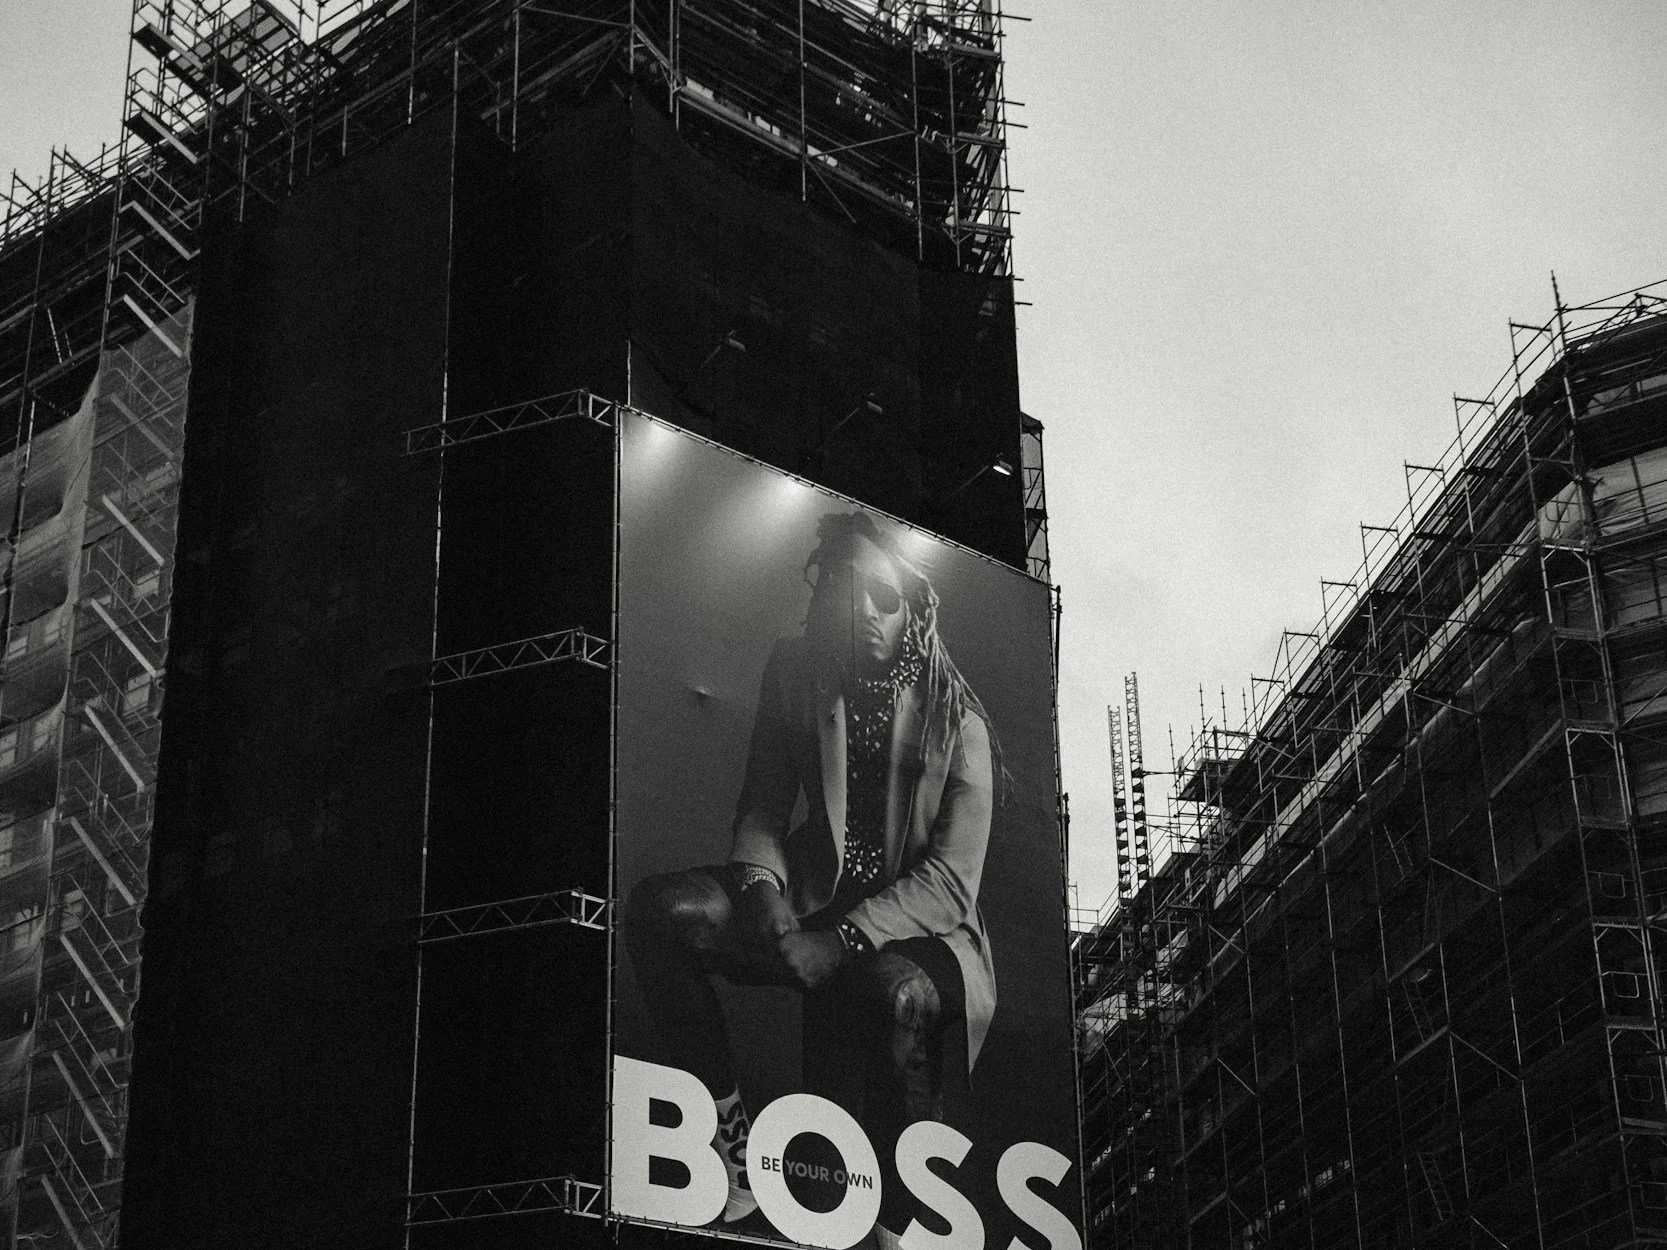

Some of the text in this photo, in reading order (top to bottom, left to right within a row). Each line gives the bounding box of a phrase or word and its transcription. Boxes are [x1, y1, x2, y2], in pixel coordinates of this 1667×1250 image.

[761, 1155, 873, 1190] BE YOUR OWN
